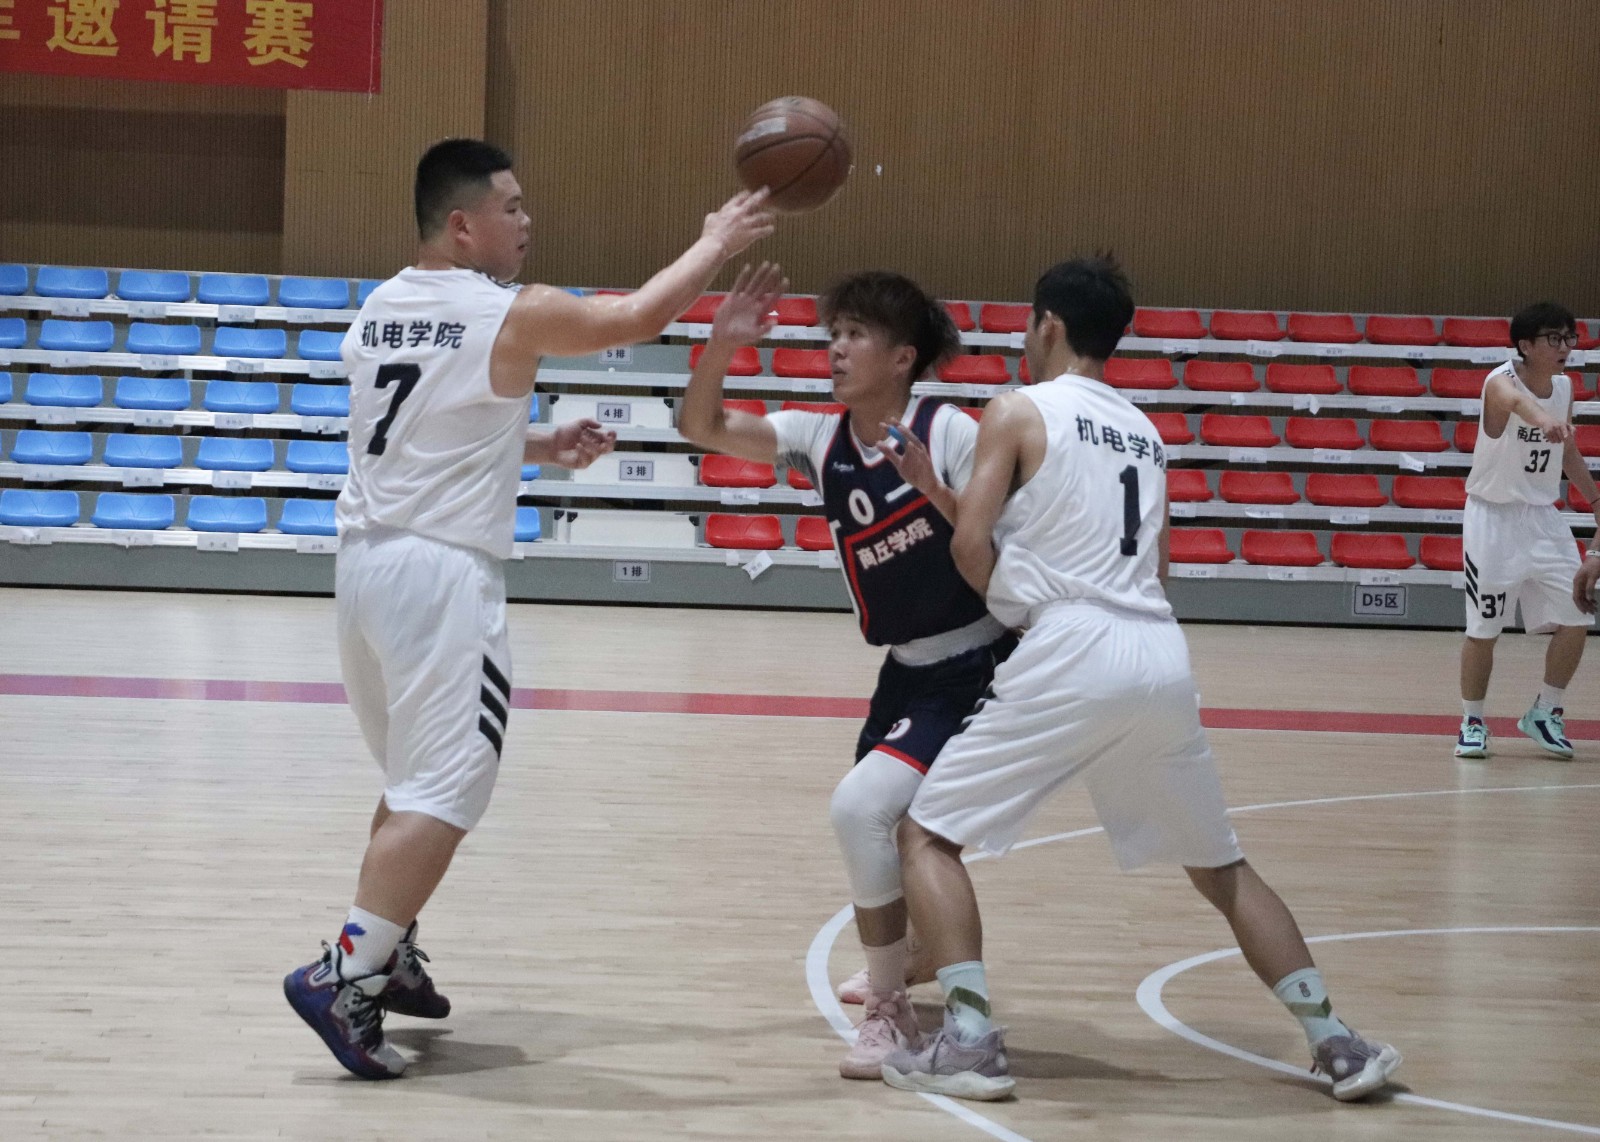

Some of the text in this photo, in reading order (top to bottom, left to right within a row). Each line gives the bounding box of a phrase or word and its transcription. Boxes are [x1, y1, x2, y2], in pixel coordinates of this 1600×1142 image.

[361, 320, 467, 349] 机电学院
[366, 362, 422, 456] 7
[1517, 426, 1548, 443] 商丘
[1524, 449, 1551, 473] 37
[848, 488, 875, 526] 0
[1119, 464, 1141, 556] 1
[856, 517, 934, 570] 商丘学院
[1362, 592, 1399, 609] D5区
[1480, 591, 1507, 619] 37
